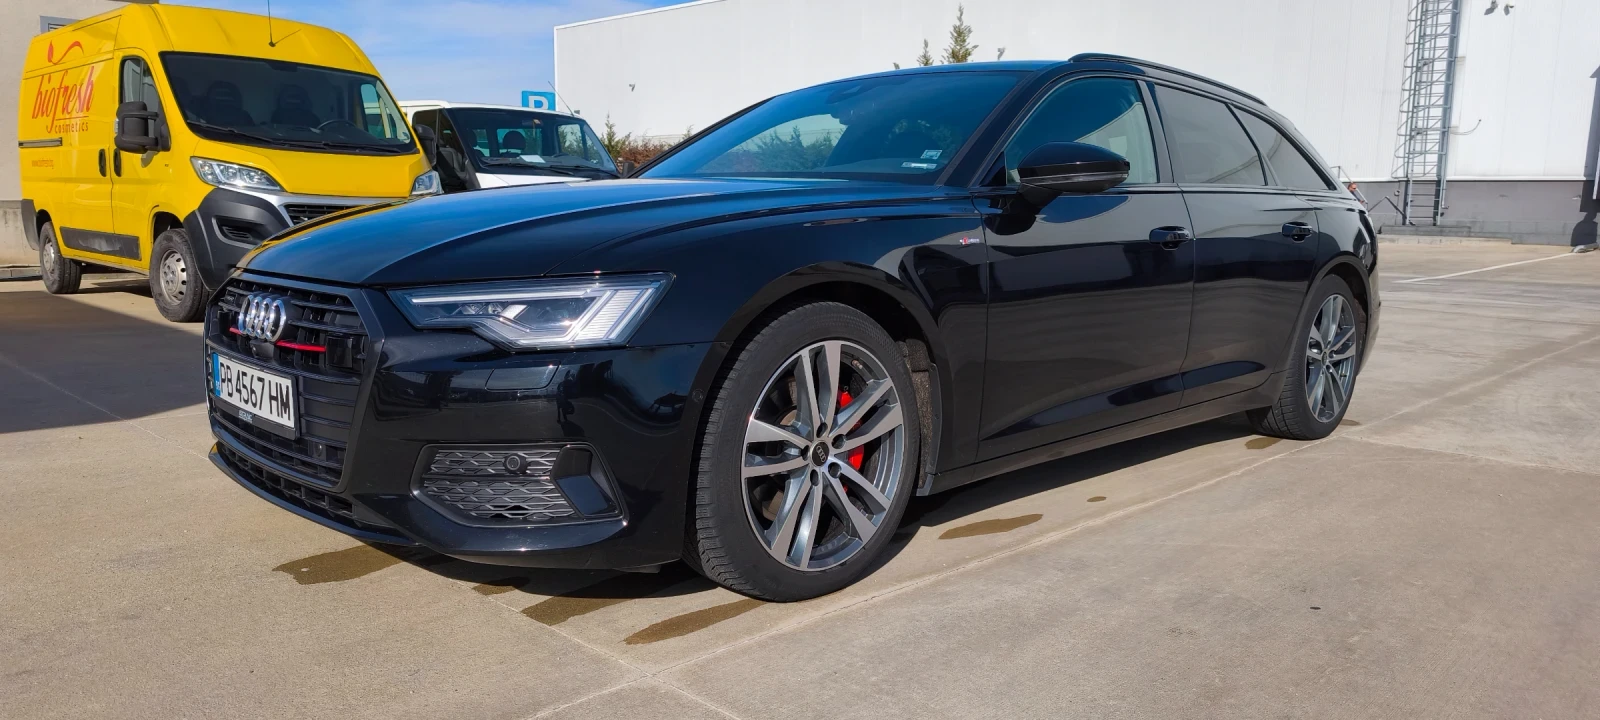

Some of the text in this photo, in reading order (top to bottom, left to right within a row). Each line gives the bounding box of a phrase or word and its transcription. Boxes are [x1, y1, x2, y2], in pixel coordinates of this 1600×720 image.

[32, 66, 94, 133] biofresh
[55, 122, 88, 134] cosmetics
[219, 361, 291, 421] PB 4567 HM
